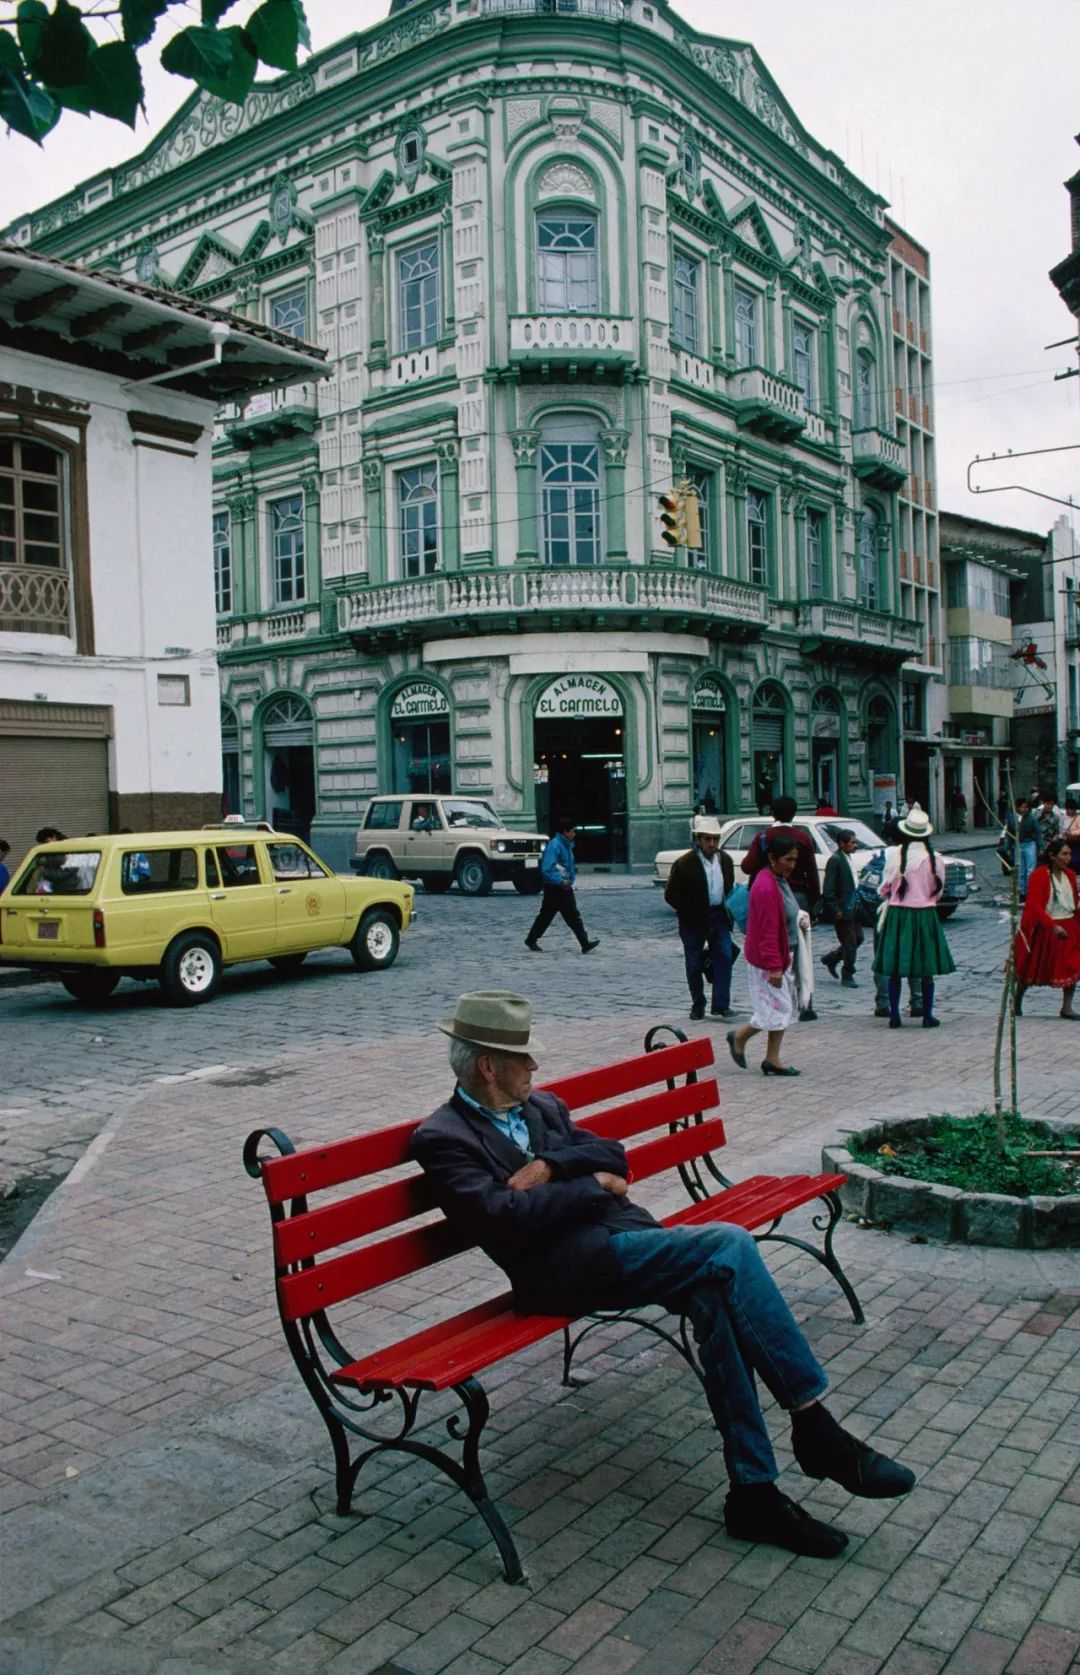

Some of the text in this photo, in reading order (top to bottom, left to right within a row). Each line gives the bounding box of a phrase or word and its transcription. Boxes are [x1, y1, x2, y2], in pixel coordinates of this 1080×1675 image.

[401, 685, 437, 701] ALMACEN
[553, 677, 607, 697] ALMACEN
[394, 702, 406, 715] EL
[540, 699, 556, 713] EL
